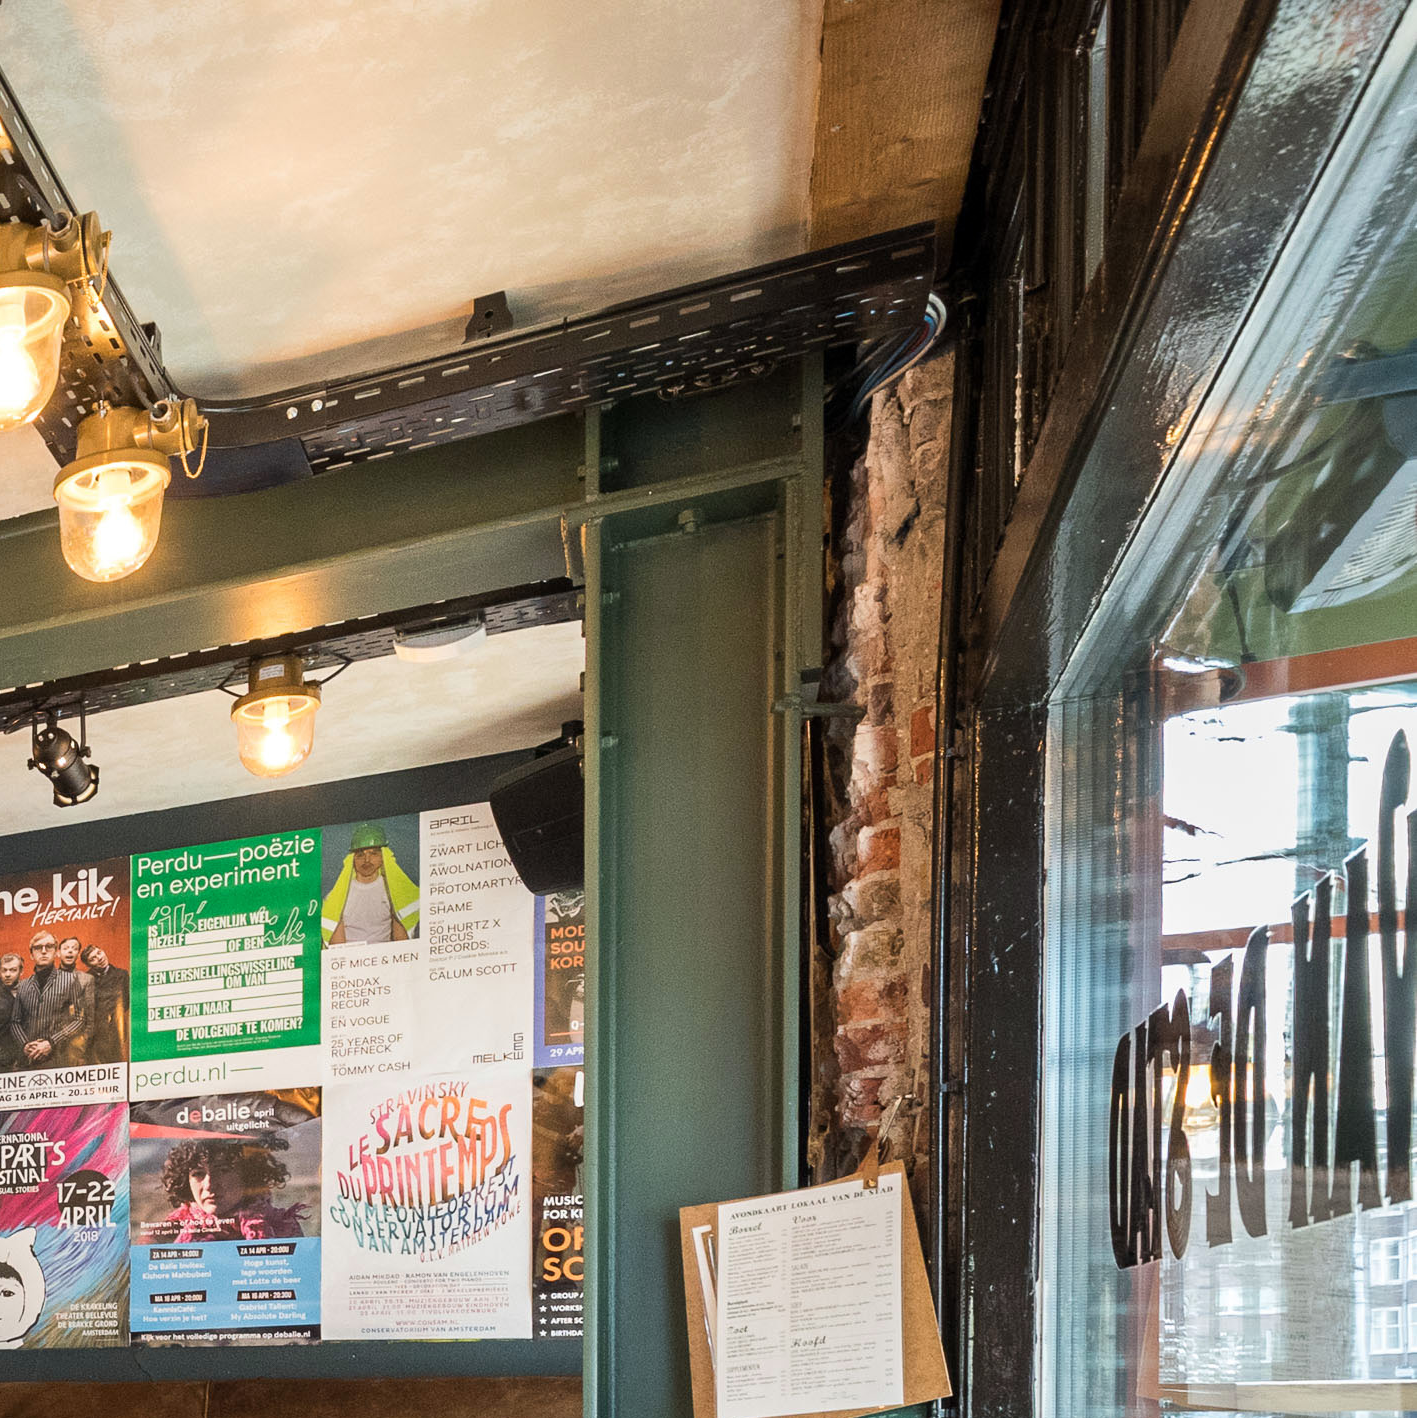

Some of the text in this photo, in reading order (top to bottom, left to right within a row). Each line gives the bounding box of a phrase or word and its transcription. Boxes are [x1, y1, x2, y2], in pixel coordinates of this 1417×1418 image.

[138, 835, 315, 877] Perdu poëzie
[430, 843, 473, 858] ZWART
[430, 858, 513, 877] AWOLNATION
[137, 858, 300, 899] en experiment
[430, 875, 523, 896] PROTOMARTYR
[53, 868, 114, 908] kik
[31, 896, 121, 927] HERTAALT!
[429, 902, 473, 915] SHAME
[197, 913, 247, 932] EIGENLIJK
[429, 918, 501, 936] 50 HURTZ X
[148, 934, 264, 952] MEZELF OF BEN
[429, 932, 474, 945] CIRCUS
[429, 941, 490, 955] RECORDS:
[331, 952, 419, 971] OF MICE & MEN
[550, 956, 584, 970] KOR
[148, 957, 295, 985] EEN VERSNELLINGSWISSELING
[429, 962, 517, 982] CALUM SCOTT
[226, 973, 265, 989] OM VAN
[331, 976, 380, 990] BONDAX
[331, 985, 391, 1000] PRESENTS
[148, 1001, 230, 1021] DE ENE ZIN NAAR
[331, 999, 370, 1010] RECUR
[176, 1017, 304, 1042] DE VOLGENDE TE KOMEN?
[331, 1015, 390, 1029] EN VOGUE
[331, 1034, 403, 1049] 25 YEARS OF
[331, 1045, 392, 1058] RUFFNECK
[550, 1048, 561, 1058] 29
[55, 1067, 120, 1085] KOMEDIE
[135, 1061, 226, 1093] perdu.nl
[333, 1061, 411, 1077] TOMMY CASH
[15, 1093, 26, 1101] 16
[29, 1090, 58, 1100] APRIL
[68, 1088, 95, 1097] 20.15
[98, 1085, 119, 1095] UUR
[369, 1081, 469, 1125] STRAVINSKY
[254, 1108, 275, 1118] april
[226, 1120, 270, 1132] uitgelicht
[337, 1103, 512, 1213] DU PRINTEMPS
[349, 1134, 370, 1171] LE
[15, 1185, 39, 1194] STORIES
[56, 1180, 115, 1203] 17-22
[330, 1175, 519, 1240] CONSERVATORIUM
[543, 1195, 583, 1207] MUSIC
[730, 1205, 787, 1220] AVONDKAART
[791, 1197, 827, 1209] LOKAAL
[832, 1193, 850, 1202] VAN
[57, 1204, 116, 1230] APRIL
[543, 1209, 568, 1220] FOR
[353, 1200, 509, 1255] VAN AMSTERDAM
[728, 1215, 817, 1236] Borrel Voor
[73, 1231, 98, 1242] 2018
[550, 1292, 578, 1300] GROUP
[94, 1320, 118, 1328] GROND
[550, 1317, 572, 1325] AFTER
[361, 1326, 429, 1334] CONSERVATORIUM
[790, 1336, 826, 1348] Hoofd
